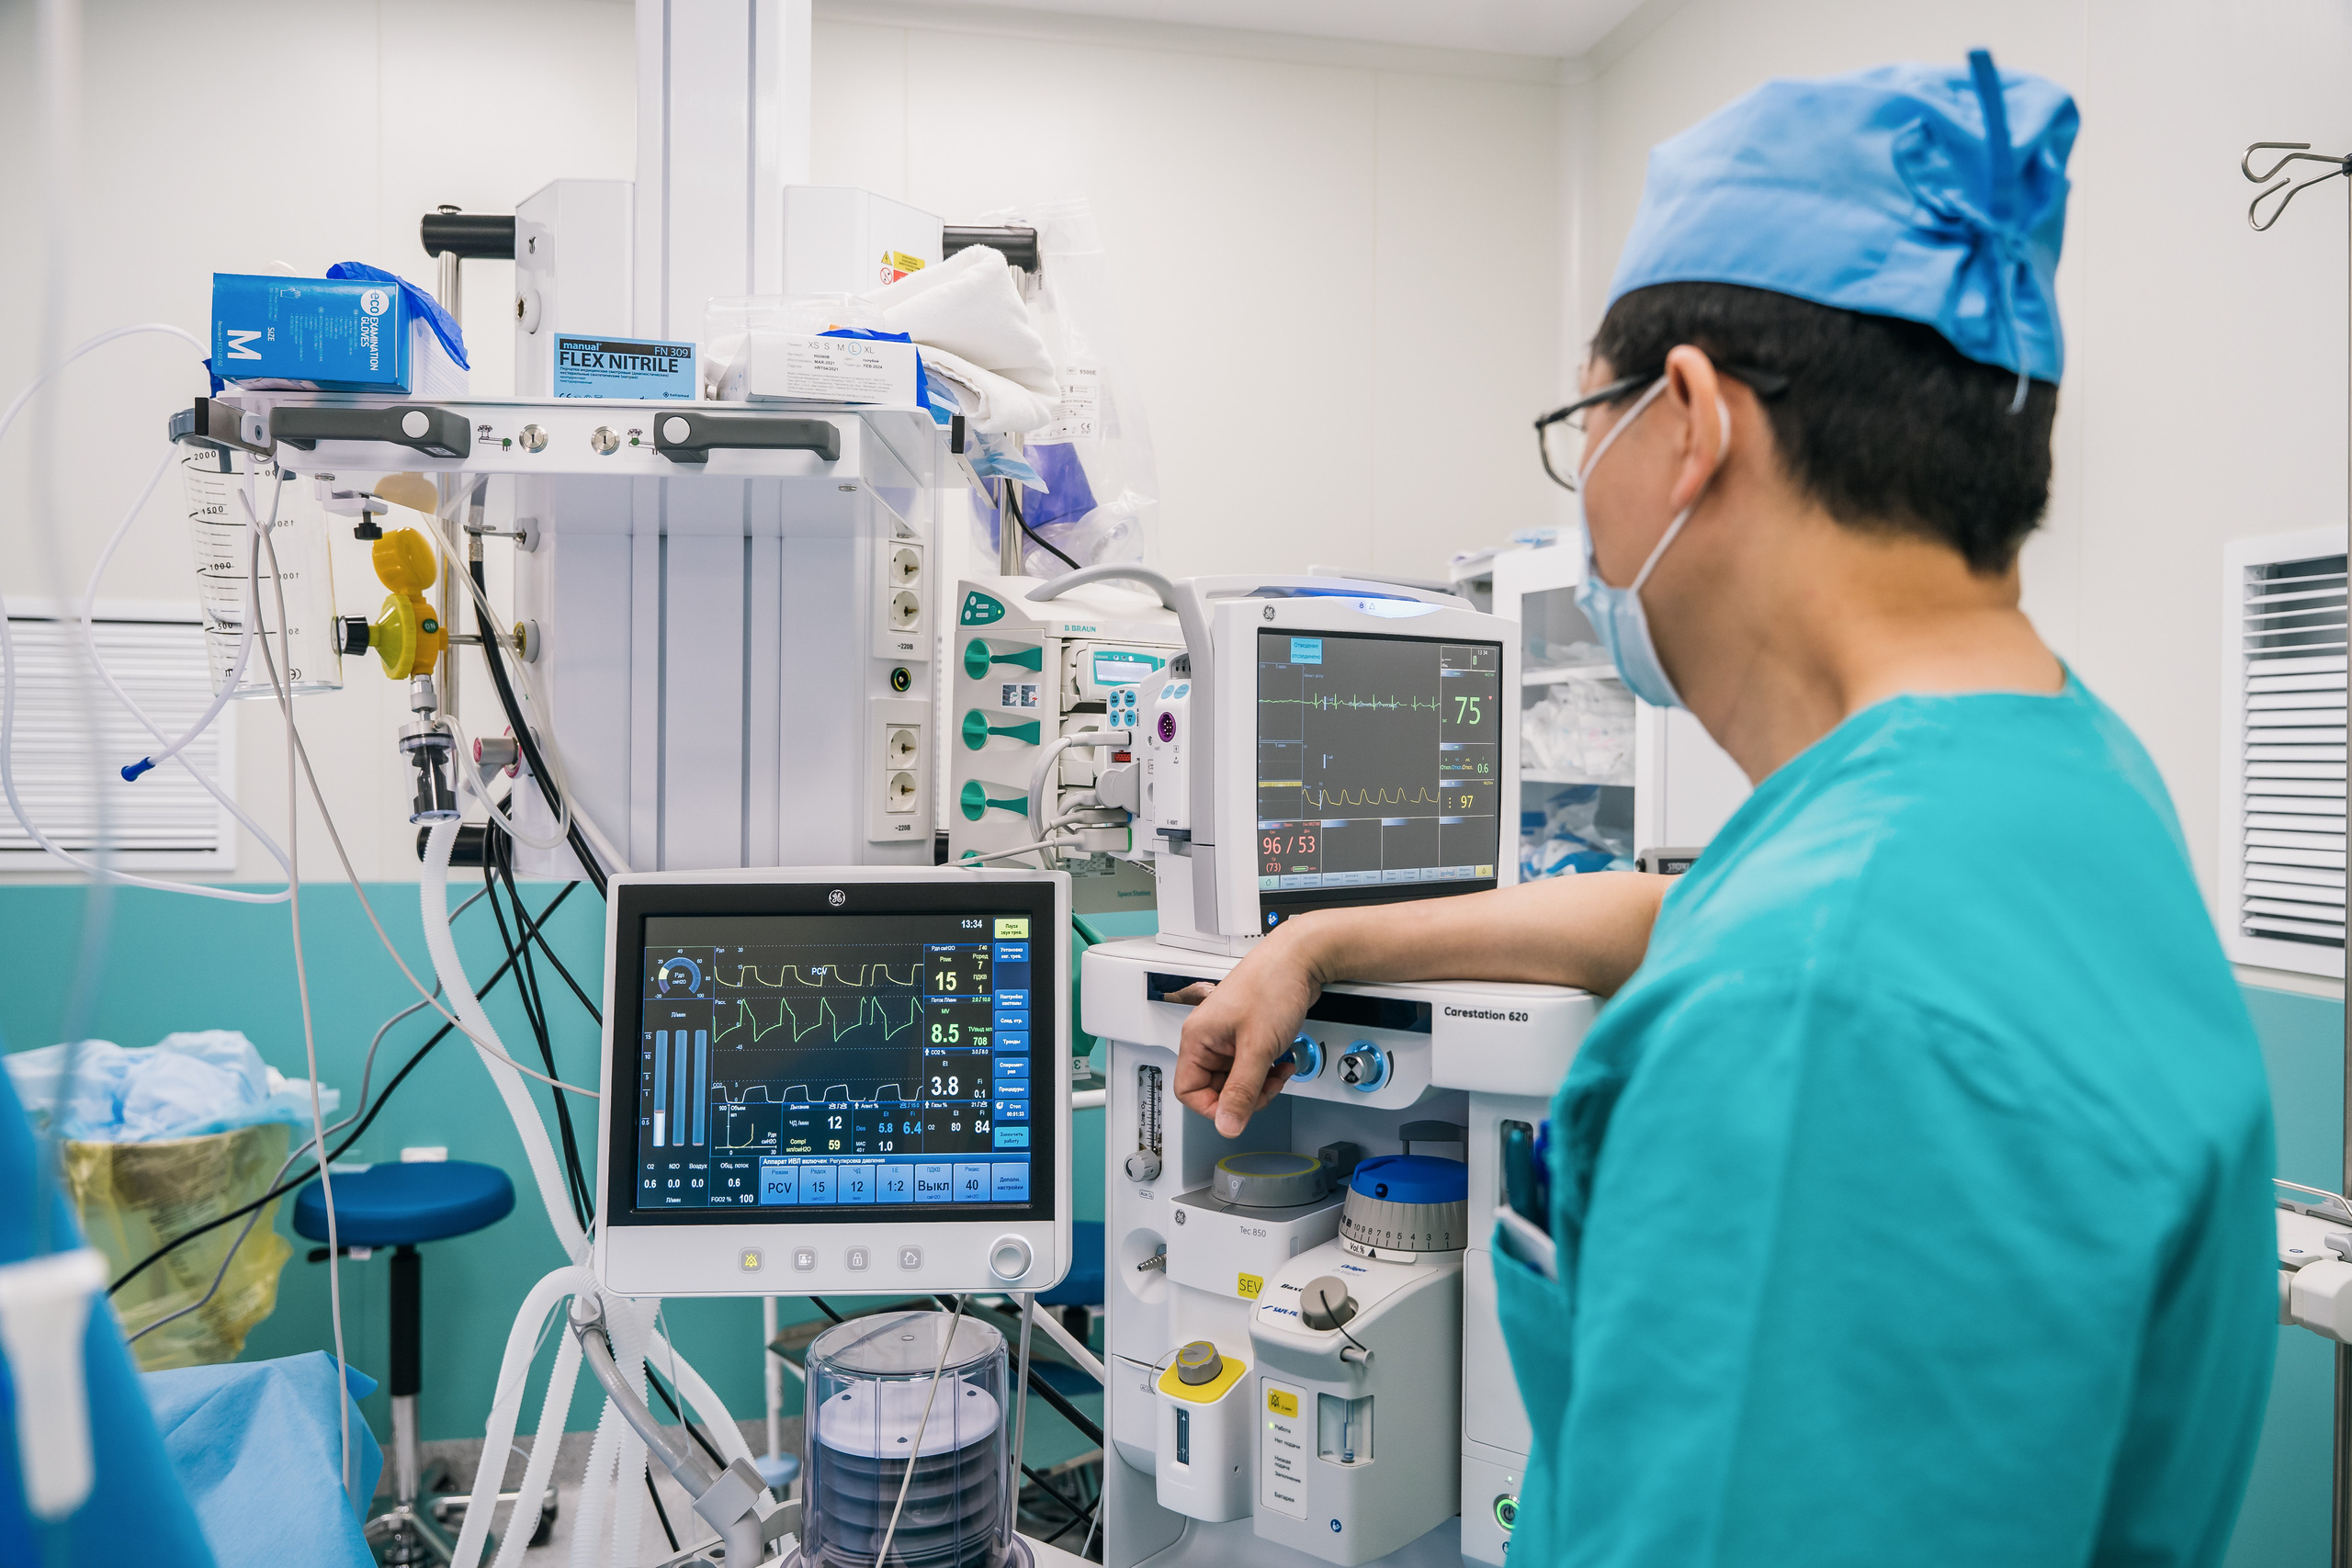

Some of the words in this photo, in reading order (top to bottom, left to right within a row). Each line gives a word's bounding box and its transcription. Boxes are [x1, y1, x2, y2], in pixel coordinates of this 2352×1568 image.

[369, 290, 379, 314] eco
[267, 327, 276, 342] SIZE
[361, 317, 369, 347] GLOVES
[227, 330, 262, 360] M
[370, 317, 379, 371] EXAMINATION
[808, 342, 820, 350] XS
[824, 343, 831, 351] S
[865, 346, 875, 355] XL
[654, 346, 668, 356] FN
[671, 348, 689, 357] 309
[560, 352, 605, 368] FLEX
[609, 355, 679, 373] NITRILE
[194, 450, 217, 461] 2000
[202, 506, 224, 515] 1500
[209, 562, 232, 572] 1000
[218, 623, 233, 631] 500
[1455, 696, 1481, 725] 75
[1477, 763, 1489, 773] 0.6
[1461, 795, 1474, 808] 97
[1263, 837, 1282, 855] 96
[1286, 837, 1295, 854] /
[1298, 836, 1316, 854] 53
[1266, 863, 1282, 874] (73)
[961, 919, 983, 929] 13:34
[978, 961, 983, 970] 7
[811, 967, 828, 976] PCV
[935, 971, 957, 991] 15
[978, 985, 983, 994] 1
[1444, 1006, 1506, 1021] Carestation
[1510, 1011, 1529, 1022] 620
[931, 1023, 960, 1043] 8.5
[973, 1037, 988, 1046] 708
[931, 1076, 960, 1096] 3.8
[974, 1089, 986, 1099] 0.1
[827, 1116, 842, 1130] 12
[878, 1122, 894, 1134] 5.8
[903, 1122, 922, 1135] 6.4
[951, 1122, 961, 1132] 80
[975, 1121, 990, 1134] 84
[828, 1140, 841, 1151] 59
[878, 1141, 894, 1152] 1.0
[644, 1179, 657, 1189] 0.6
[668, 1179, 681, 1189] 0.0
[692, 1179, 705, 1189] 0.0
[728, 1179, 741, 1188] 0.6
[768, 1182, 793, 1194] PCV
[812, 1182, 826, 1193] 15
[851, 1181, 865, 1192] 12
[887, 1180, 905, 1192] 1:2
[918, 1180, 950, 1191] Выкл
[966, 1179, 979, 1190] 40
[740, 1194, 754, 1203] 100
[1240, 1226, 1251, 1235] Tec
[1252, 1229, 1267, 1238] 850
[1354, 1224, 1361, 1232] 10
[1361, 1225, 1366, 1234] 9
[1350, 1242, 1365, 1255] Vol.%
[1239, 1279, 1262, 1294] SEV
[1275, 1424, 1292, 1434] Работа
[1283, 1441, 1301, 1450] подачи
[1274, 1455, 1292, 1465] Низкая
[1274, 1462, 1291, 1471] подача
[1275, 1471, 1301, 1483] Заполнение
[1274, 1492, 1295, 1503] Батарея
